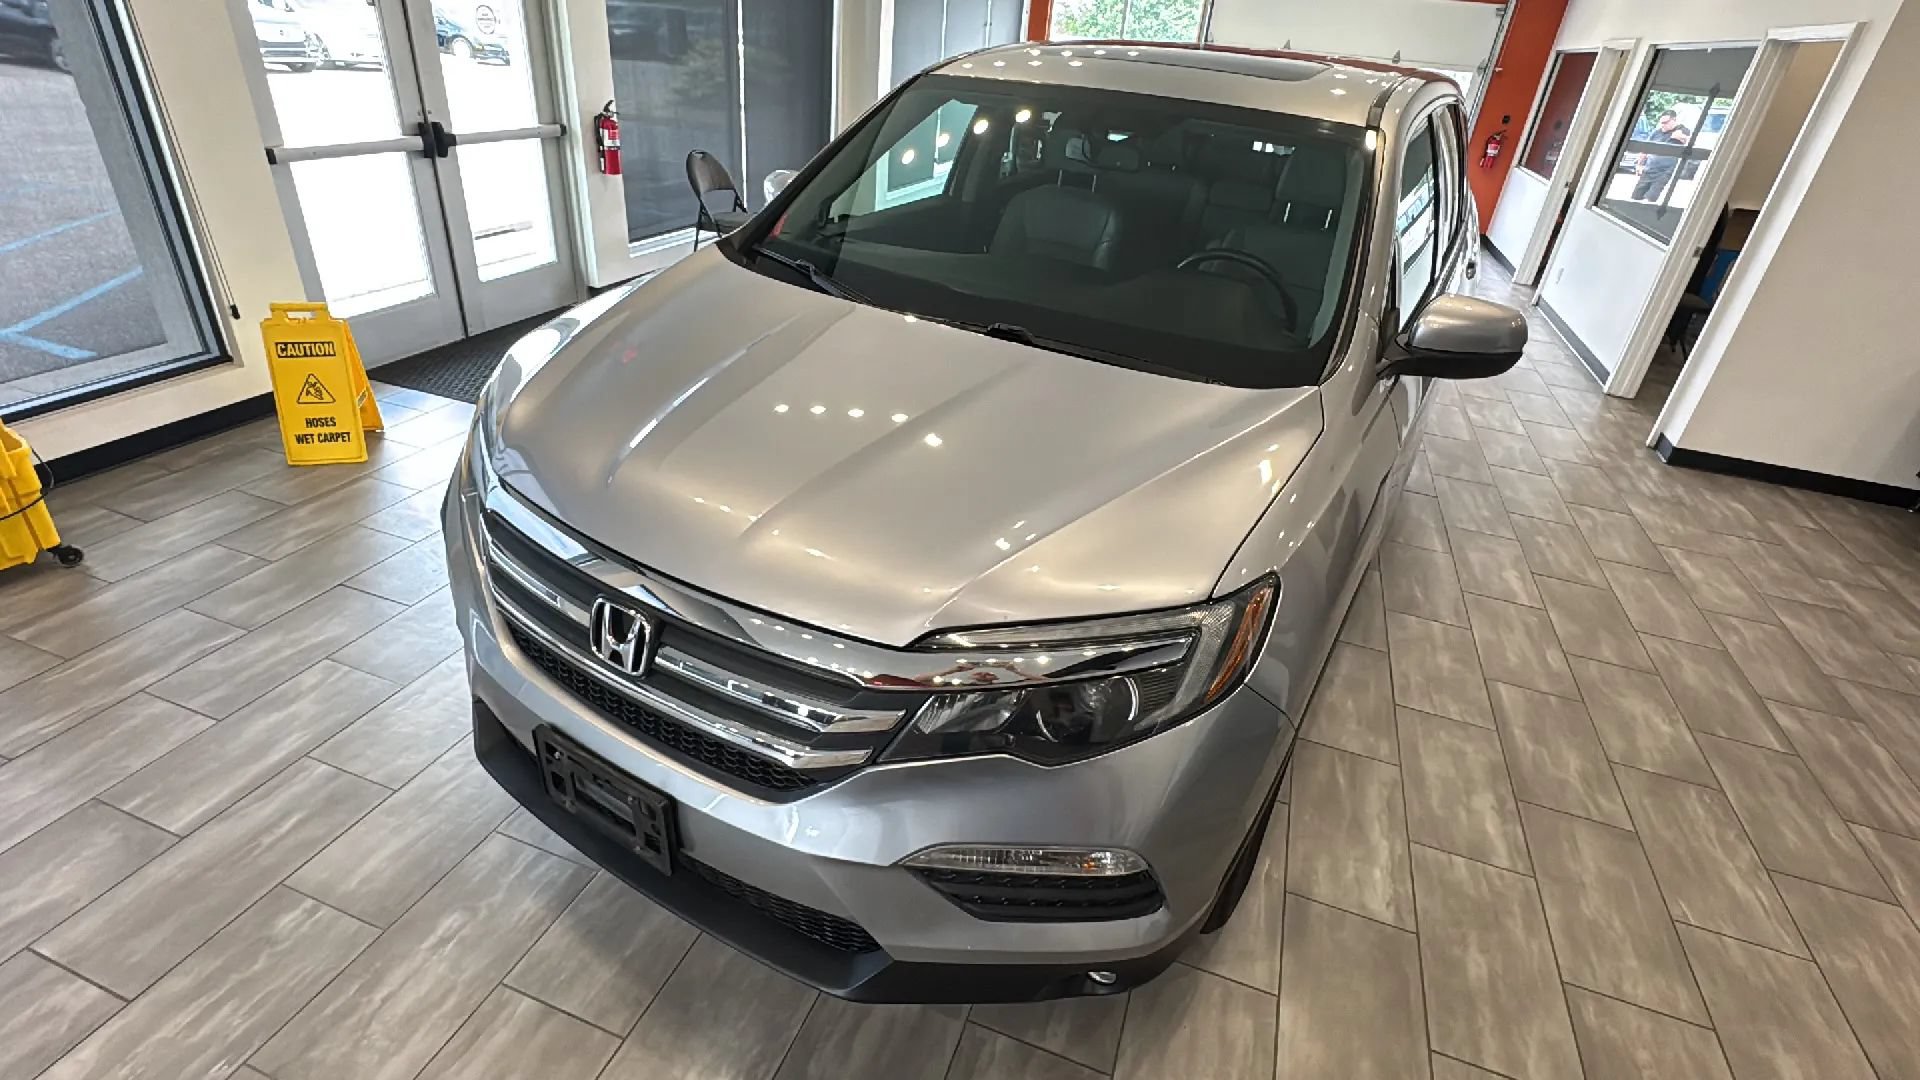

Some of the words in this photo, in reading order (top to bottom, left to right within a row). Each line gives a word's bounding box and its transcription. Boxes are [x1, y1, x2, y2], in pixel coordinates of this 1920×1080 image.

[277, 342, 335, 357] CAUTION
[305, 417, 336, 428] HOSES
[295, 433, 315, 444] WET
[317, 431, 351, 443] CARPET
